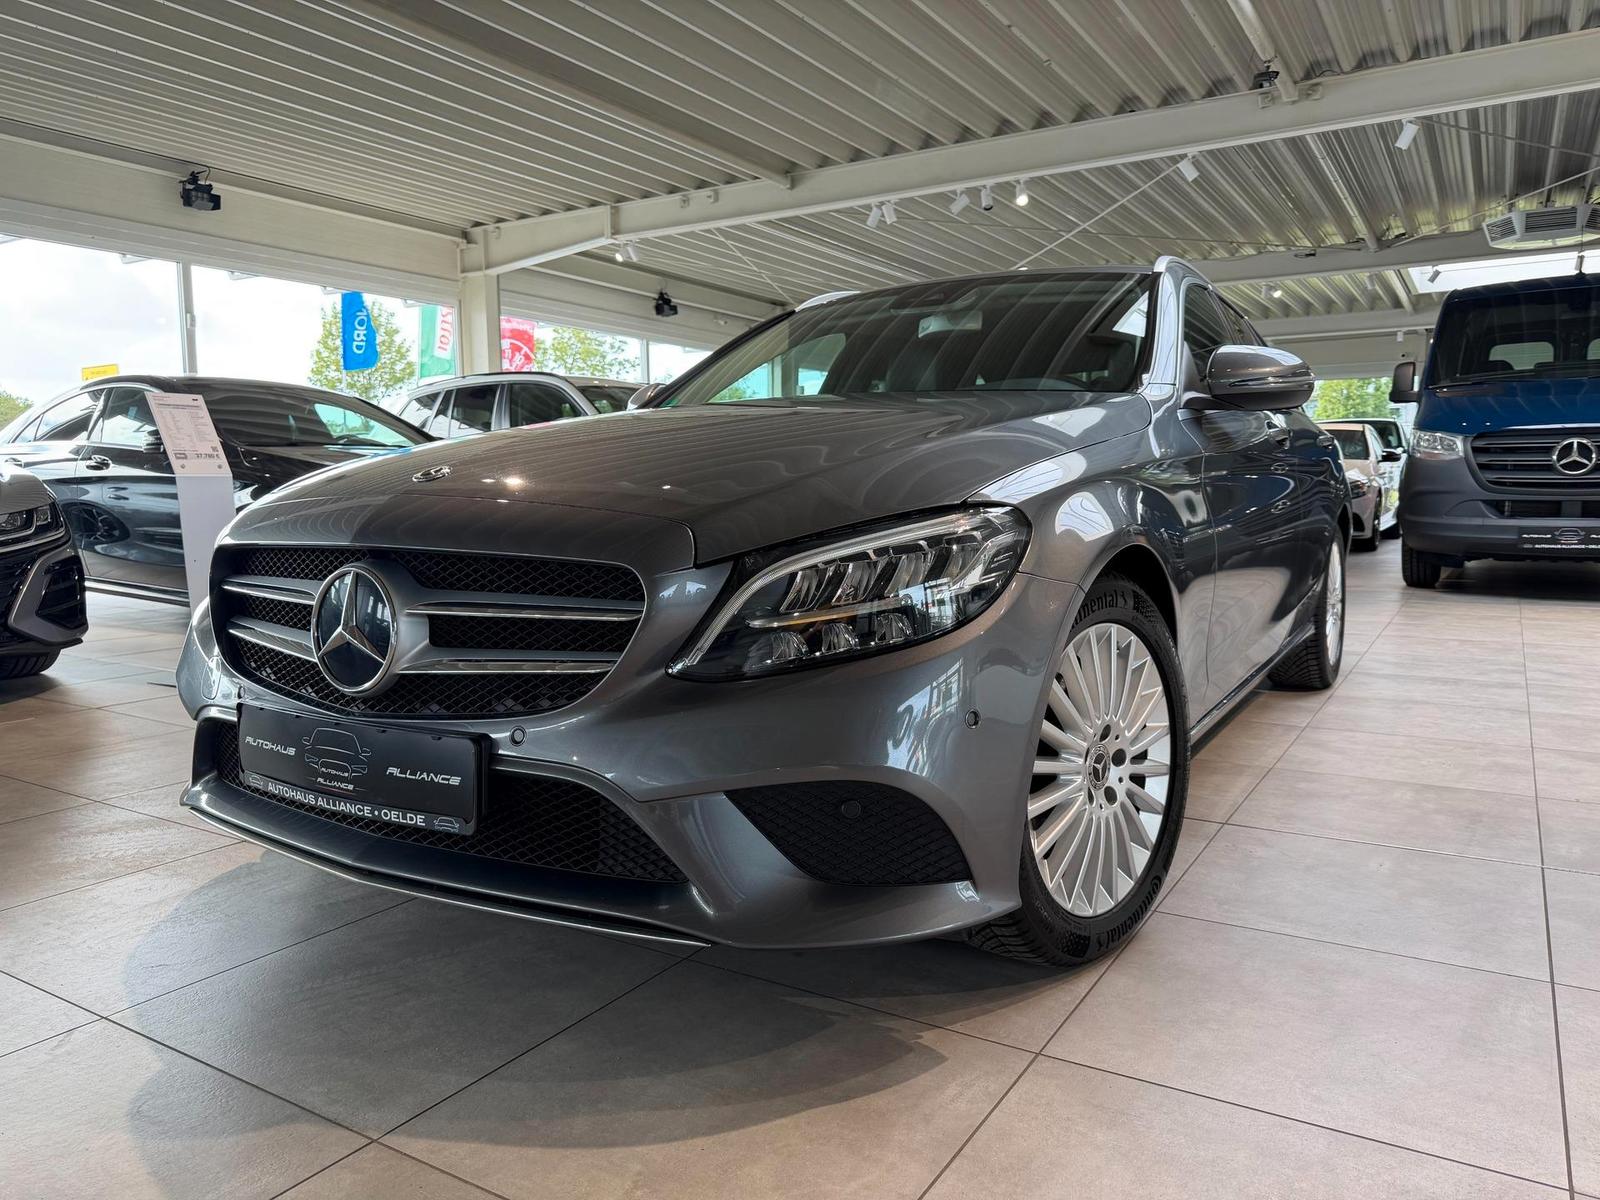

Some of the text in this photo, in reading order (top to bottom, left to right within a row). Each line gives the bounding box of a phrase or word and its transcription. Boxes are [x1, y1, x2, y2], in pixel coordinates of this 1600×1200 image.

[245, 736, 296, 756] AUTOHAUS
[320, 767, 349, 777] AUTOHAUS
[386, 766, 462, 786] ALLIANCE
[317, 777, 354, 790] ALLIANCE
[268, 782, 426, 826] AUTOHAUS ALLIANCE OELDE
[1105, 875, 1162, 949] Continental
